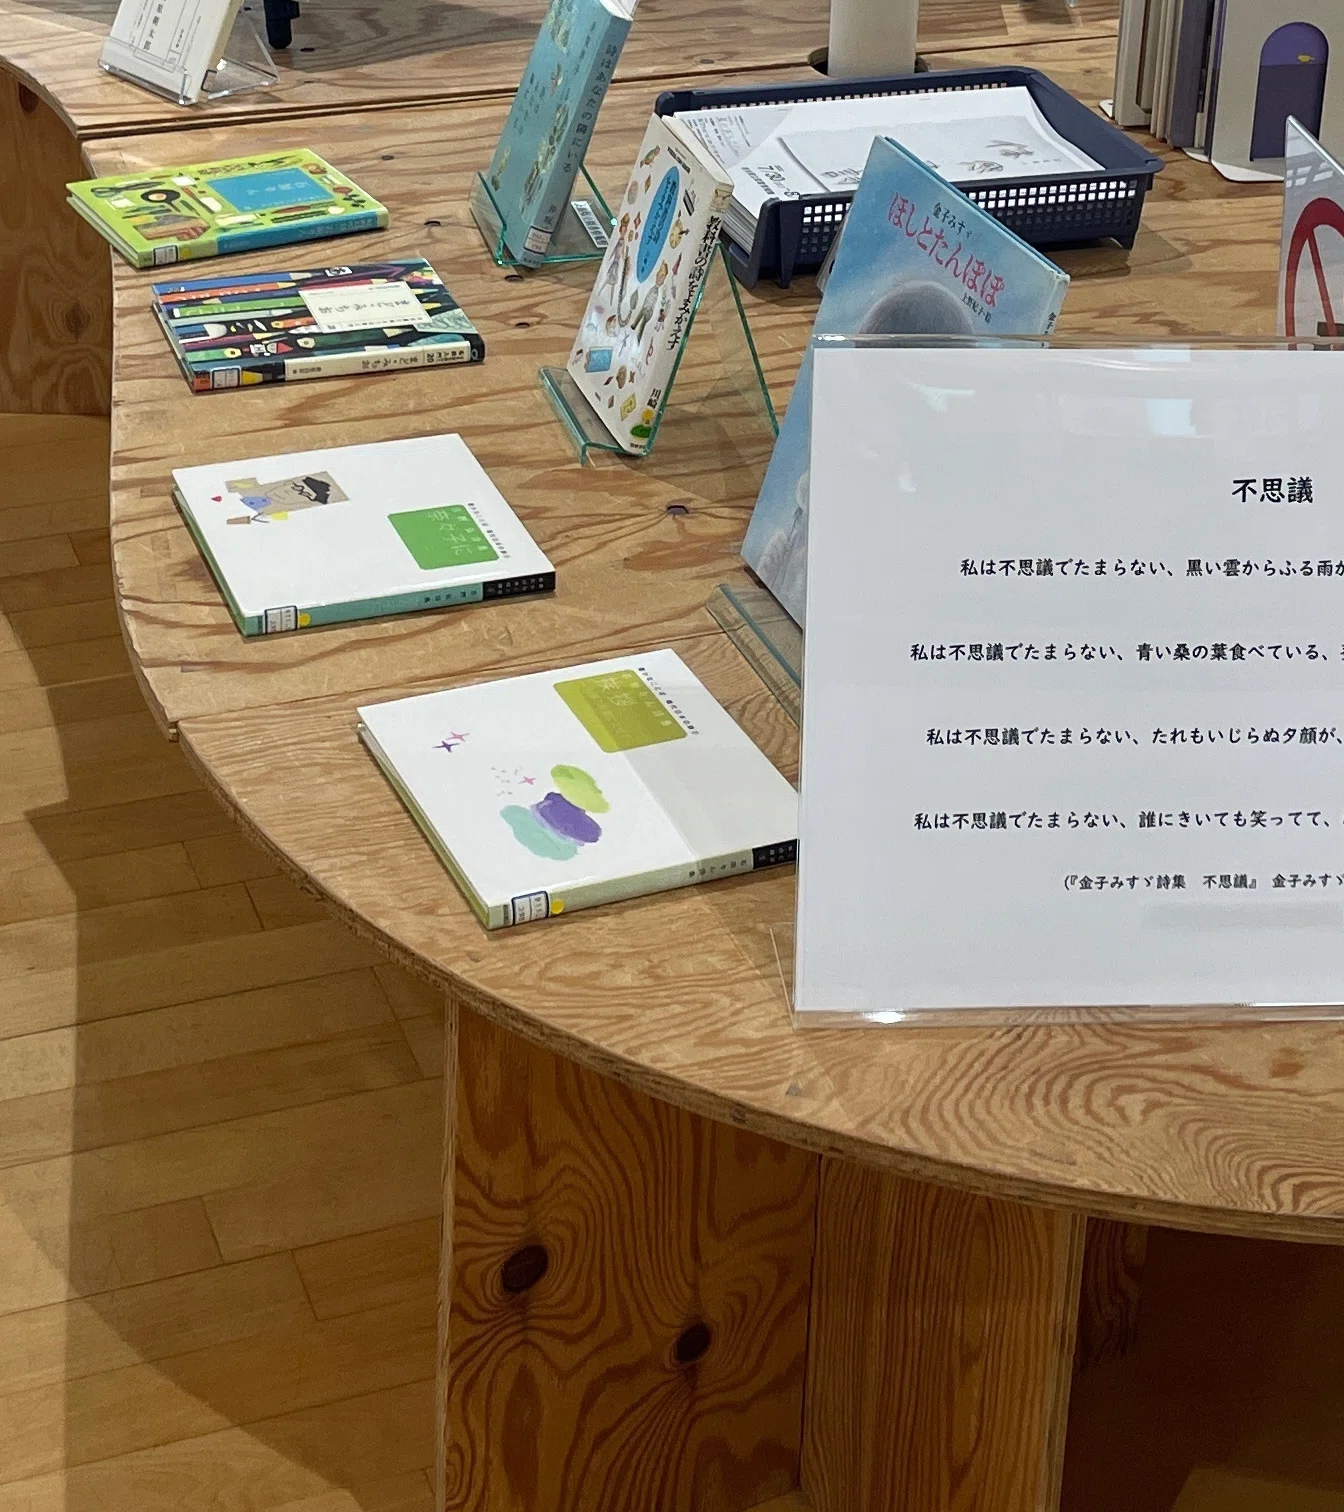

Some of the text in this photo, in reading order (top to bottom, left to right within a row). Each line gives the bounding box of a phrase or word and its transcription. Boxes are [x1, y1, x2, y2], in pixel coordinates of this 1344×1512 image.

[888, 192, 1005, 308] ほしとたんぽぽ
[1231, 477, 1314, 504] 不思議
